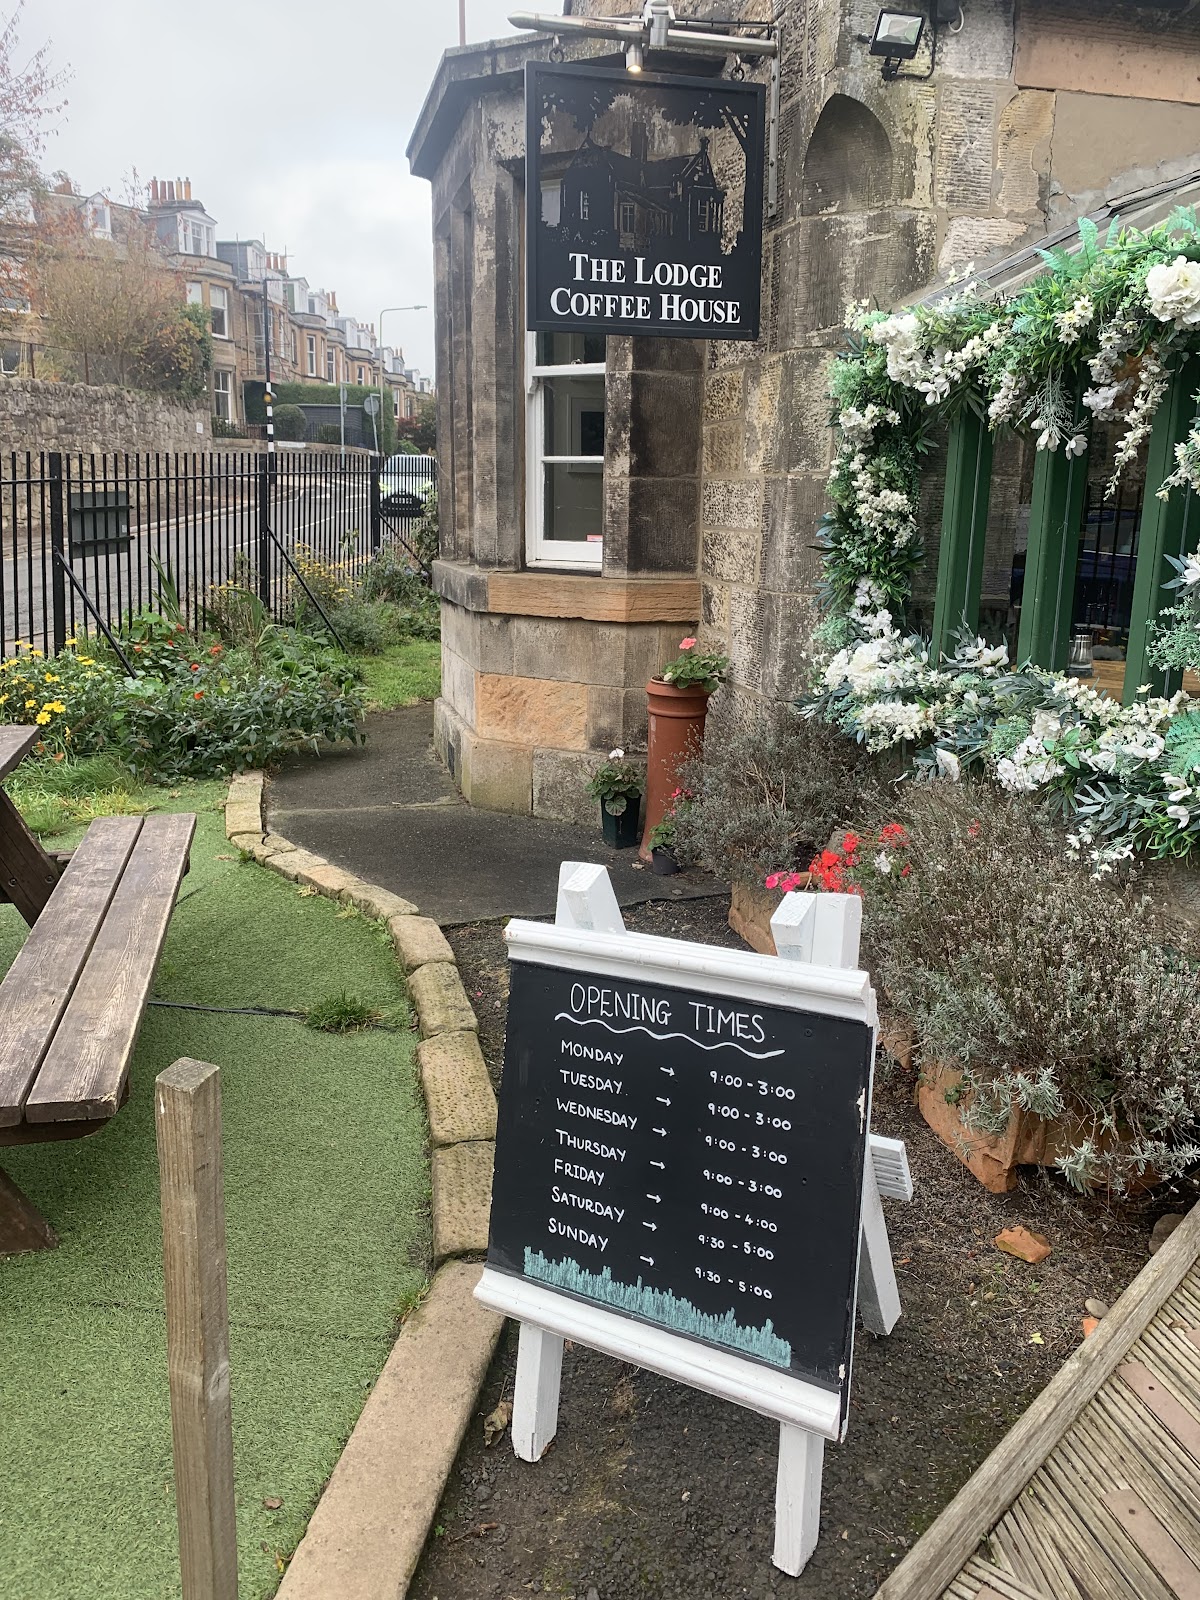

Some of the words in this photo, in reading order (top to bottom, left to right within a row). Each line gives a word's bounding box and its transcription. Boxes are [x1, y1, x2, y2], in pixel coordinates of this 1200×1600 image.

[569, 253, 626, 284] THE
[634, 257, 723, 289] LODGE
[550, 287, 652, 320] COFFEE
[659, 293, 741, 324] HOUSE
[570, 982, 672, 1026] OPENING
[688, 1001, 766, 1043] TIMES
[559, 1069, 623, 1095] TUESDAY
[707, 1102, 740, 1120] 9:00
[755, 1111, 792, 1131] 3:00
[561, 1039, 624, 1066] MONDAY
[709, 1070, 743, 1088] 9:00
[757, 1080, 796, 1101] 3:00
[555, 1128, 627, 1162] THURSDAY
[702, 1169, 733, 1186] 9:00
[747, 1179, 783, 1199] 3:00
[556, 1097, 638, 1130] WEDNESDAY
[705, 1135, 736, 1152] 9:00
[751, 1145, 788, 1165] 3:00
[551, 1185, 625, 1223] SATURDAY
[698, 1234, 725, 1250] 9:30
[743, 1241, 775, 1261] 5:00
[554, 1158, 605, 1187] FRIDAY
[700, 1202, 729, 1220] 9:00
[744, 1214, 778, 1233] 4:00
[547, 1217, 609, 1252] SUNDAY
[694, 1266, 721, 1284] 9:30
[738, 1280, 773, 1300] 5:00
